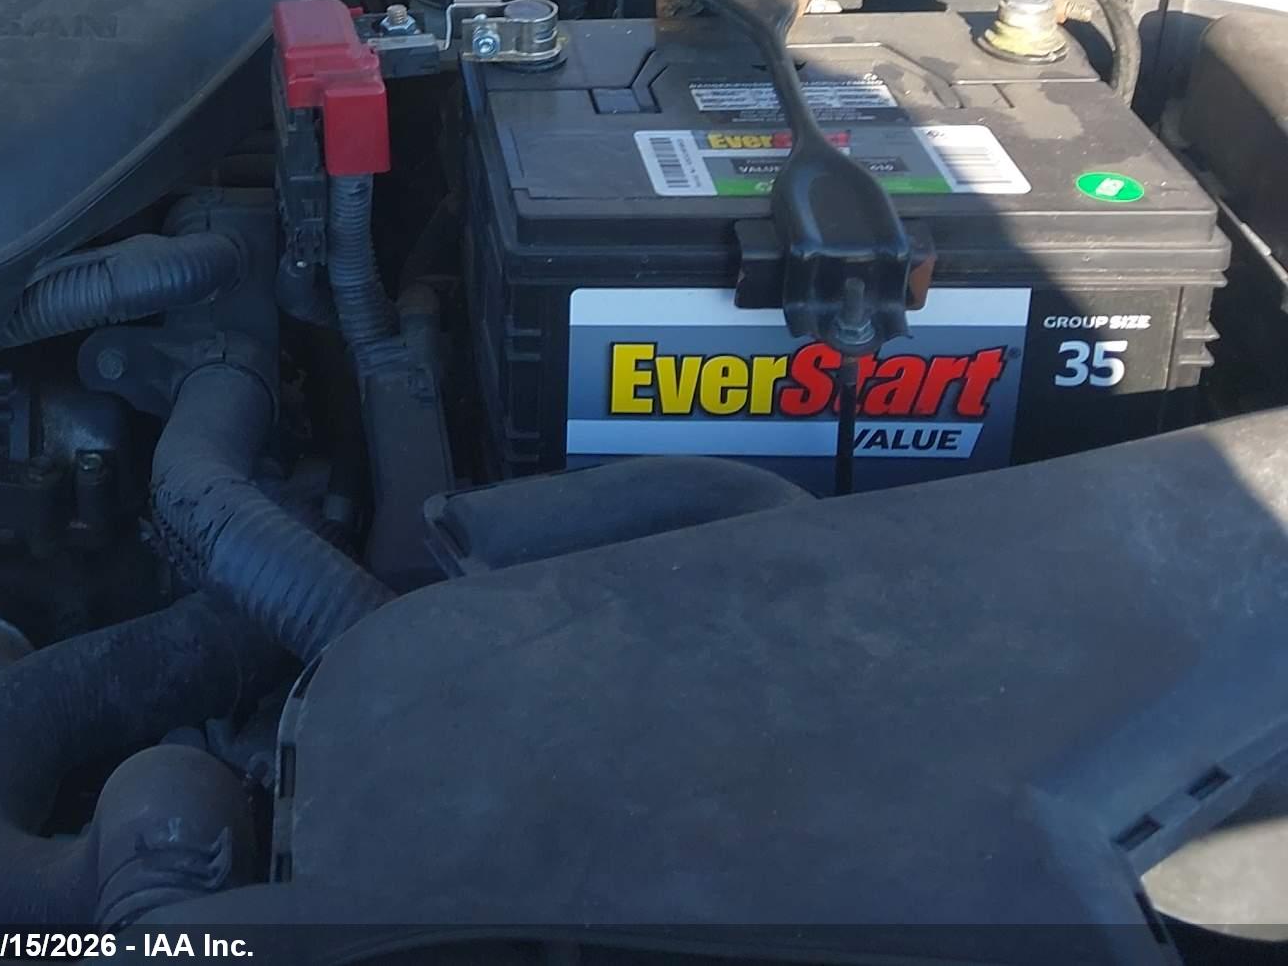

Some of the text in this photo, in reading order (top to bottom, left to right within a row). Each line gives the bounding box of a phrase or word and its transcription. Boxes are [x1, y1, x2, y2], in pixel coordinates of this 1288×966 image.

[1044, 315, 1152, 329] GROUP SIZE
[1055, 340, 1128, 387] 35
